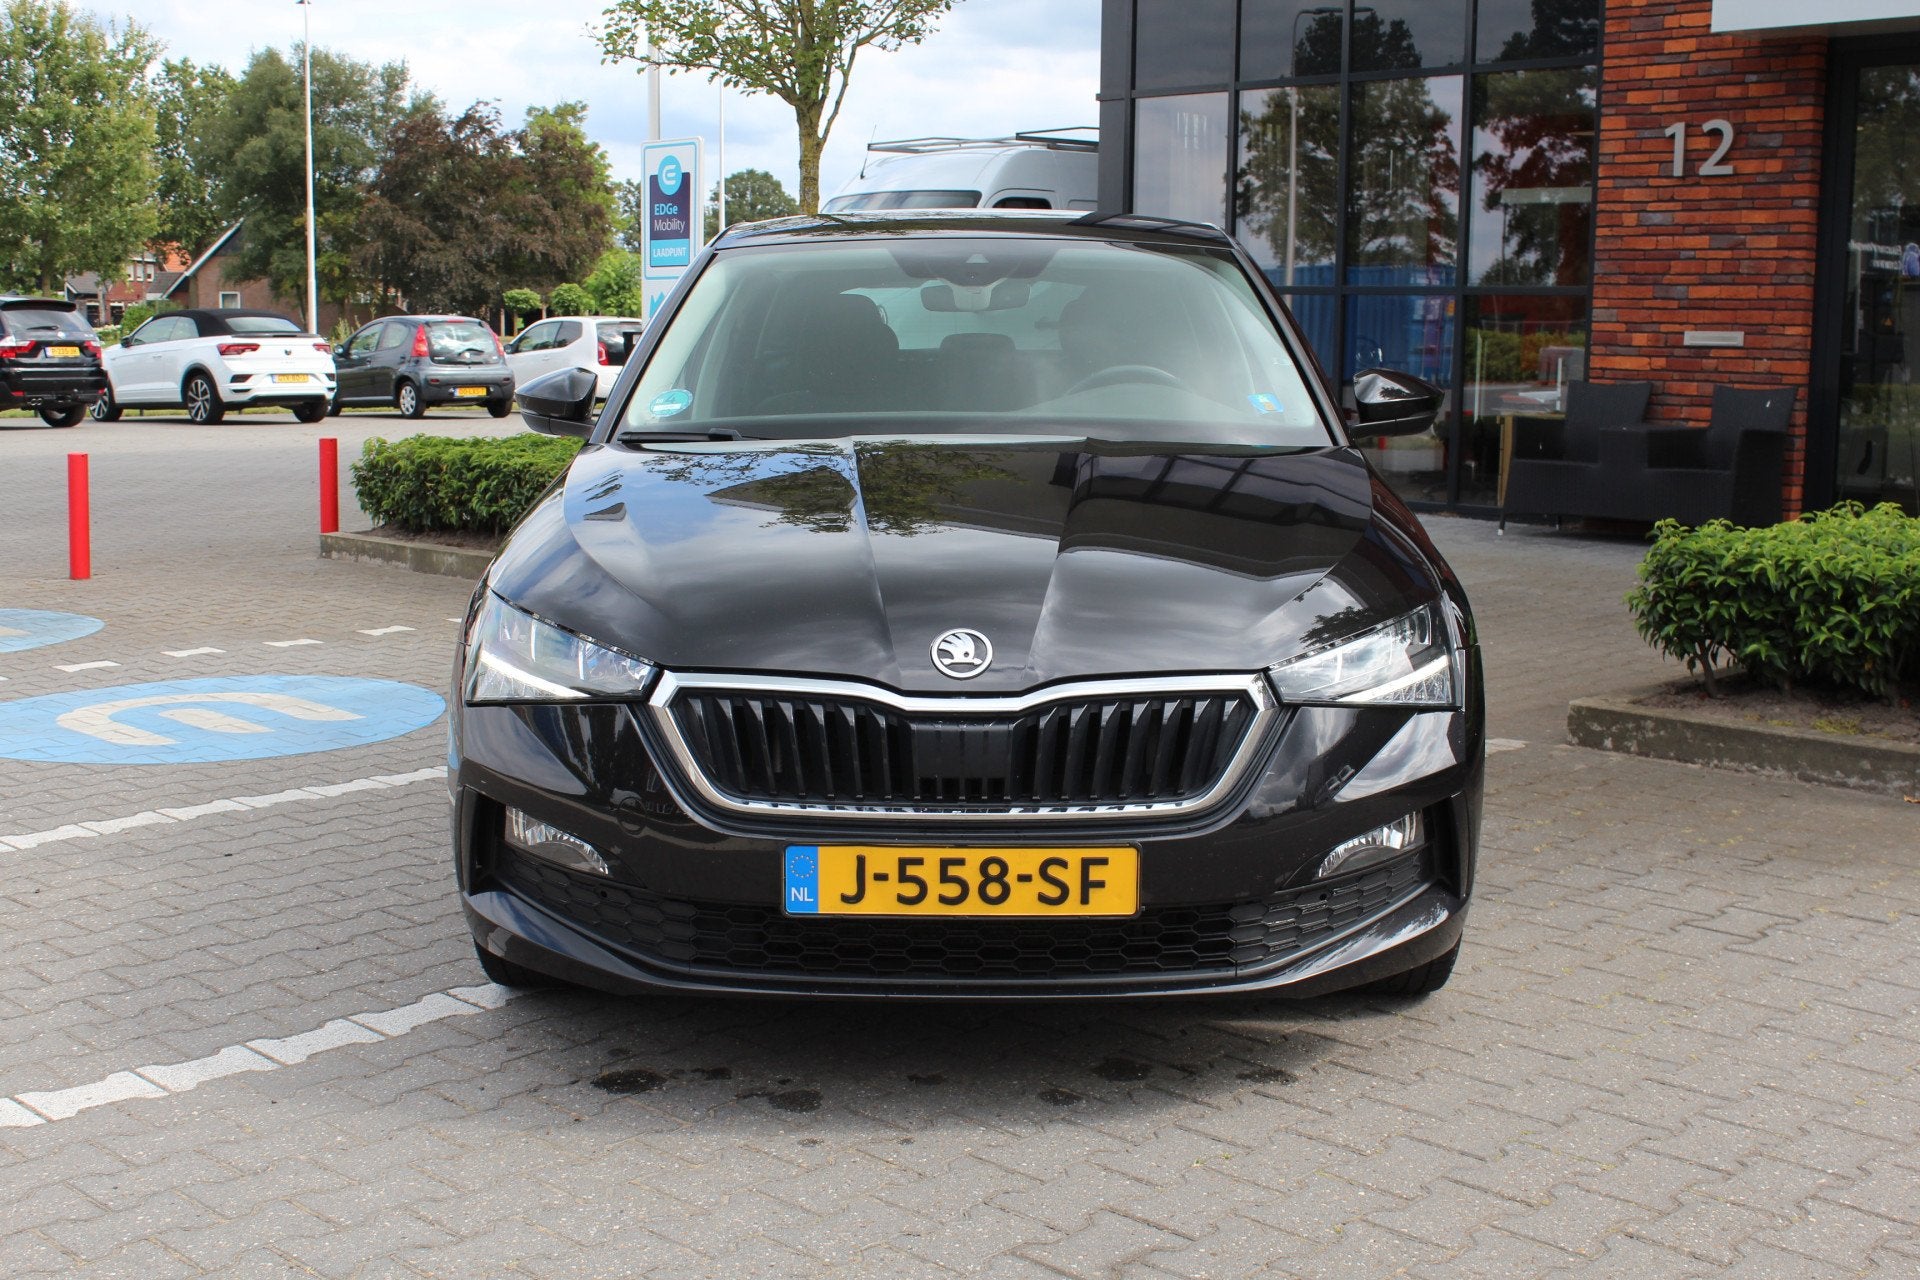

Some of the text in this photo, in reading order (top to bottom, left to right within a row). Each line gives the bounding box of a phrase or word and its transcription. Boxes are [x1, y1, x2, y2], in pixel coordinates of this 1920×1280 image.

[1664, 119, 1734, 177] 12
[654, 203, 678, 215] EDGe
[654, 218, 685, 233] Mobility
[653, 247, 687, 258] LAADPUNT
[840, 854, 1110, 905] J-558-SF
[790, 887, 814, 902] NL
